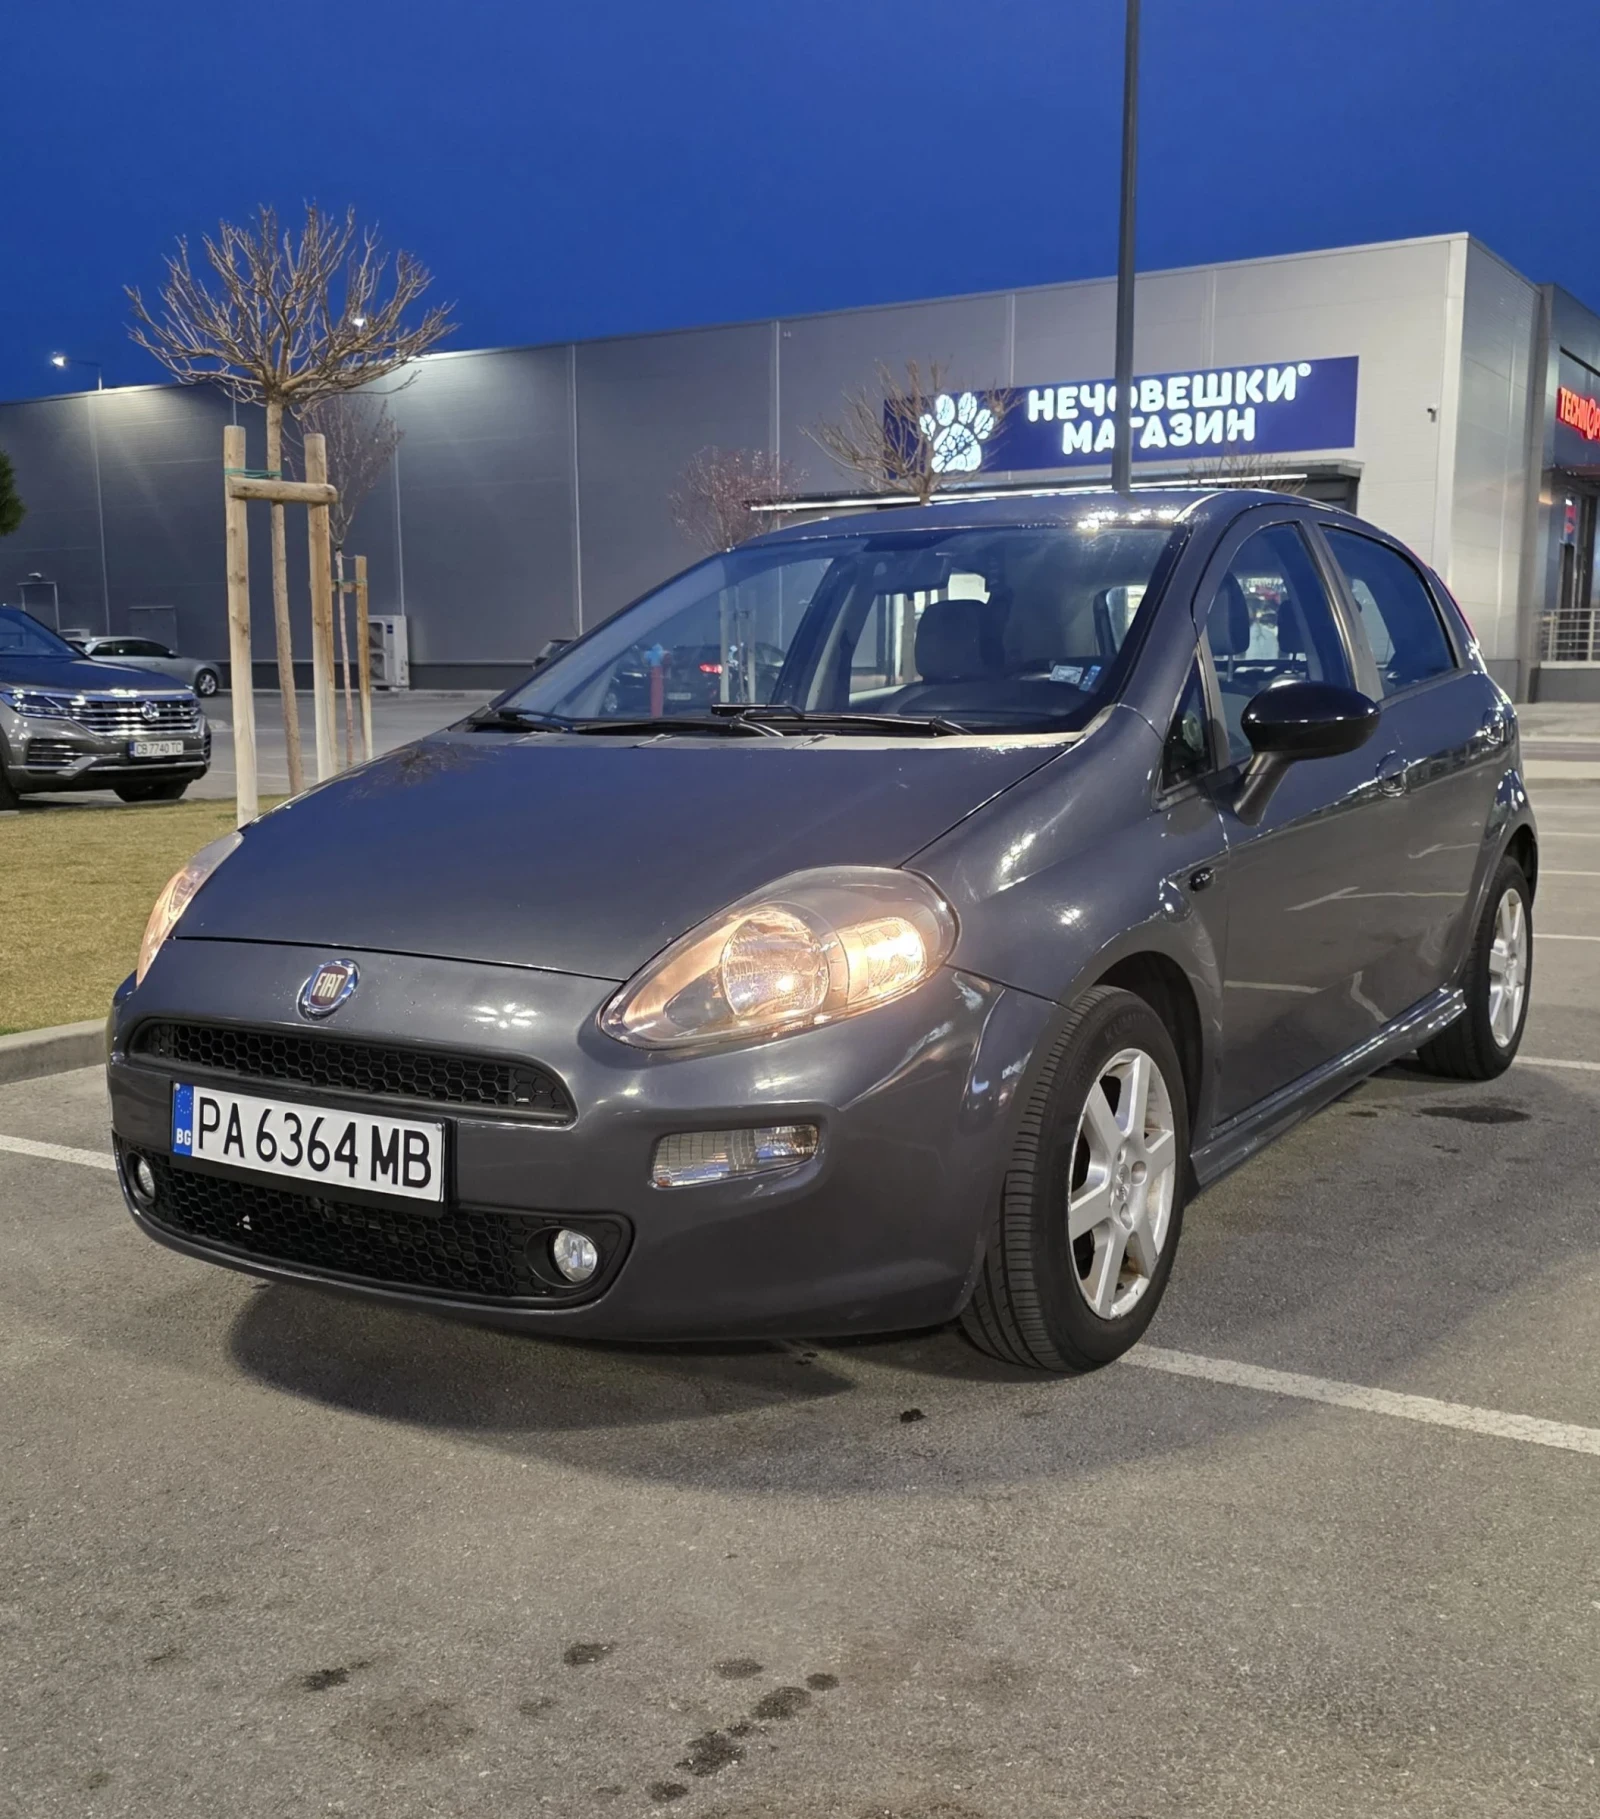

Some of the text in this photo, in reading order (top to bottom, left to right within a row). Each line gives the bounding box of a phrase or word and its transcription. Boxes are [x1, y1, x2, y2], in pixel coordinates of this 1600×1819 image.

[136, 743, 181, 755] CB 7740 TC
[312, 972, 345, 998] FIAT
[176, 1127, 191, 1146] BG
[198, 1096, 432, 1189] PA 6364 MB
